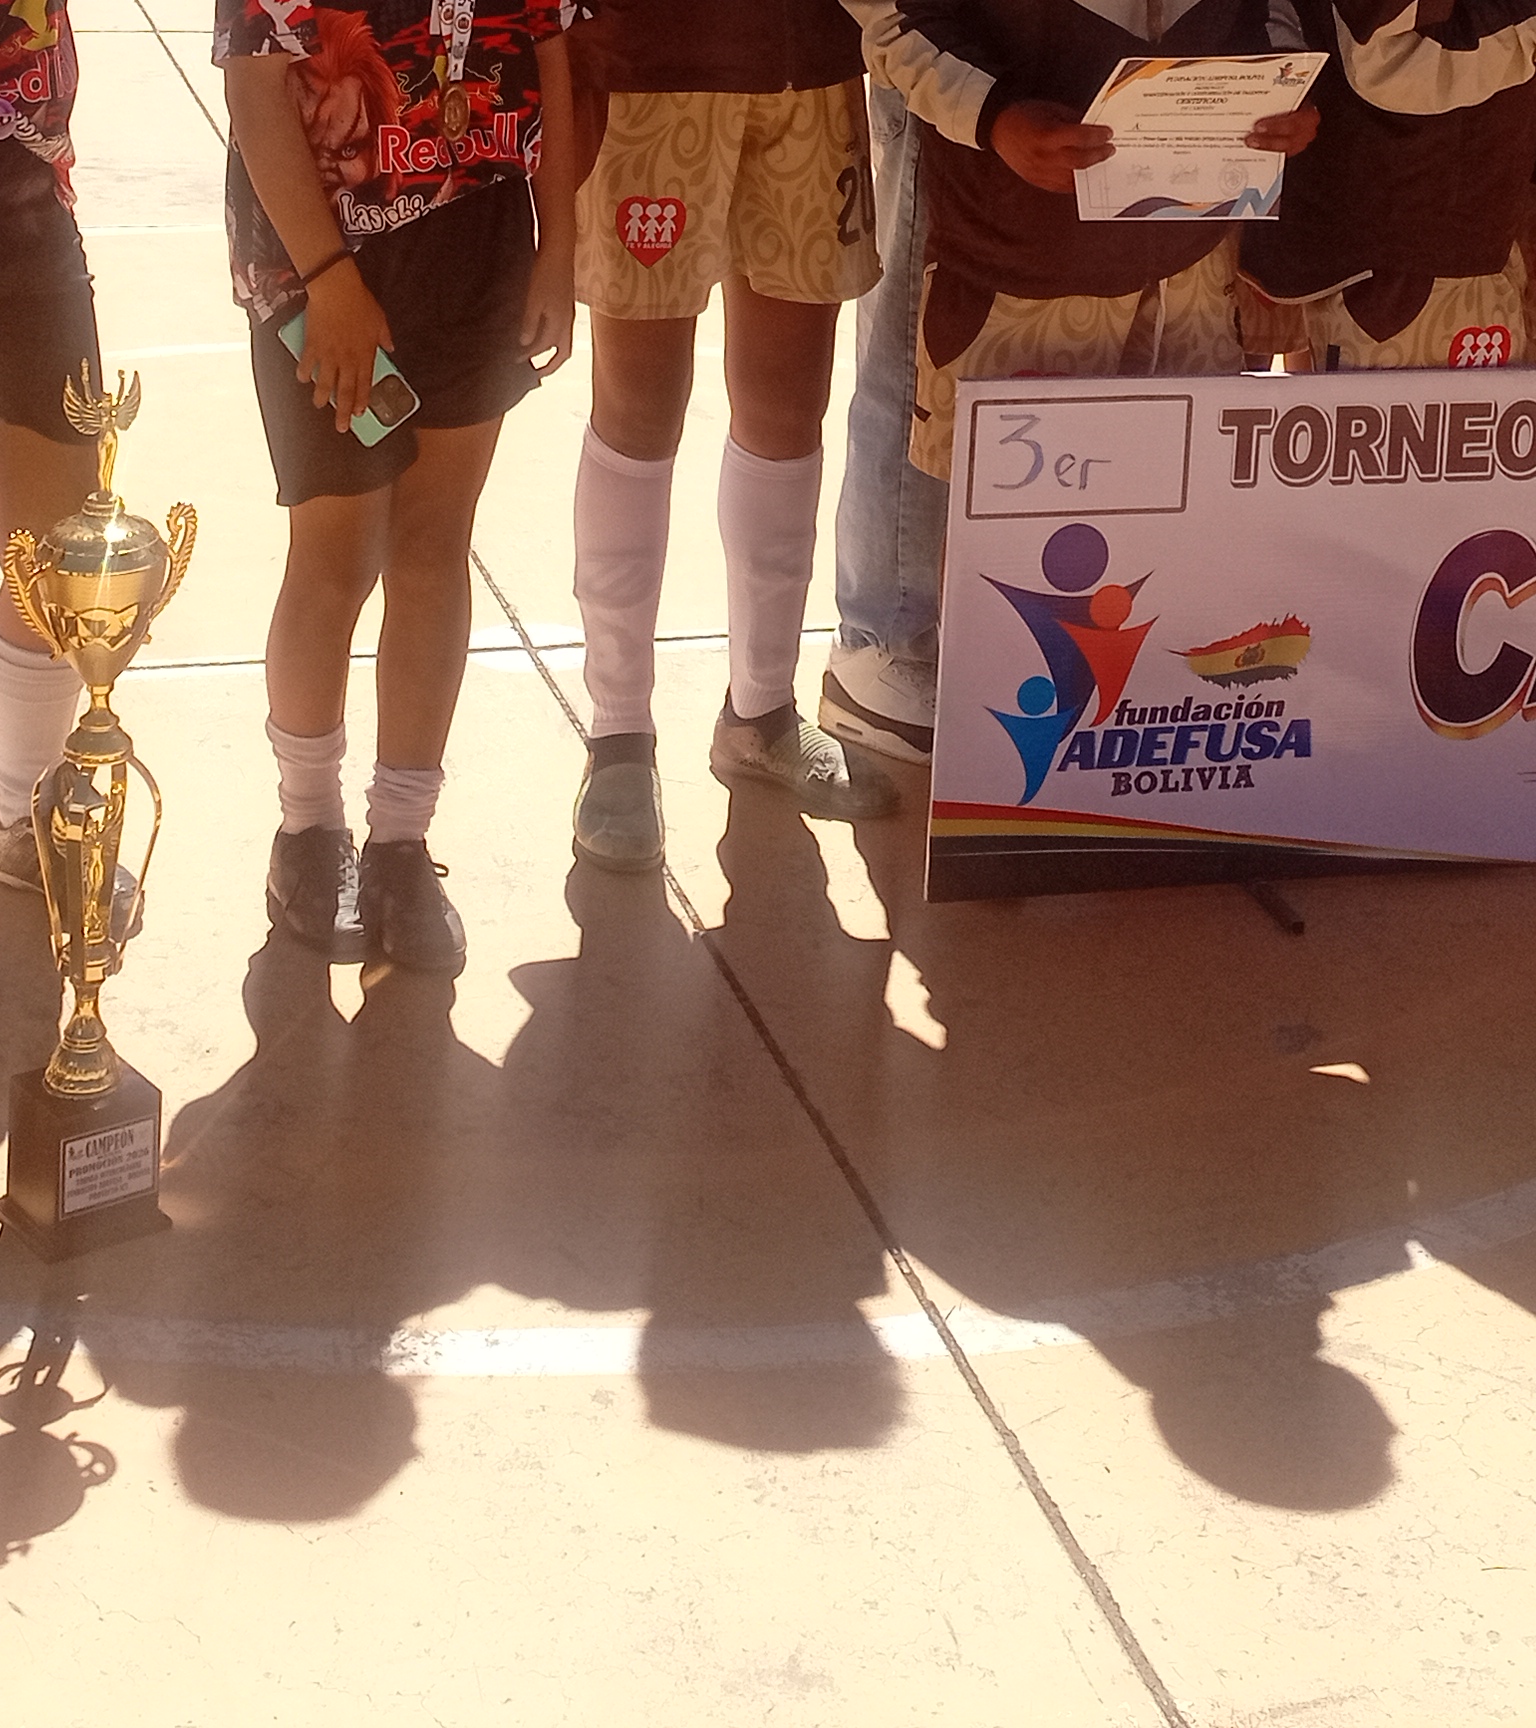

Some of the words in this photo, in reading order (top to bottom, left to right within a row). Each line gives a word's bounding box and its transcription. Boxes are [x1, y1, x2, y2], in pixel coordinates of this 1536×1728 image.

[338, 190, 386, 234] Las
[1114, 693, 1286, 727] fundación
[1057, 718, 1312, 772] ADEFUSA
[1110, 763, 1255, 797] BOLIVIA
